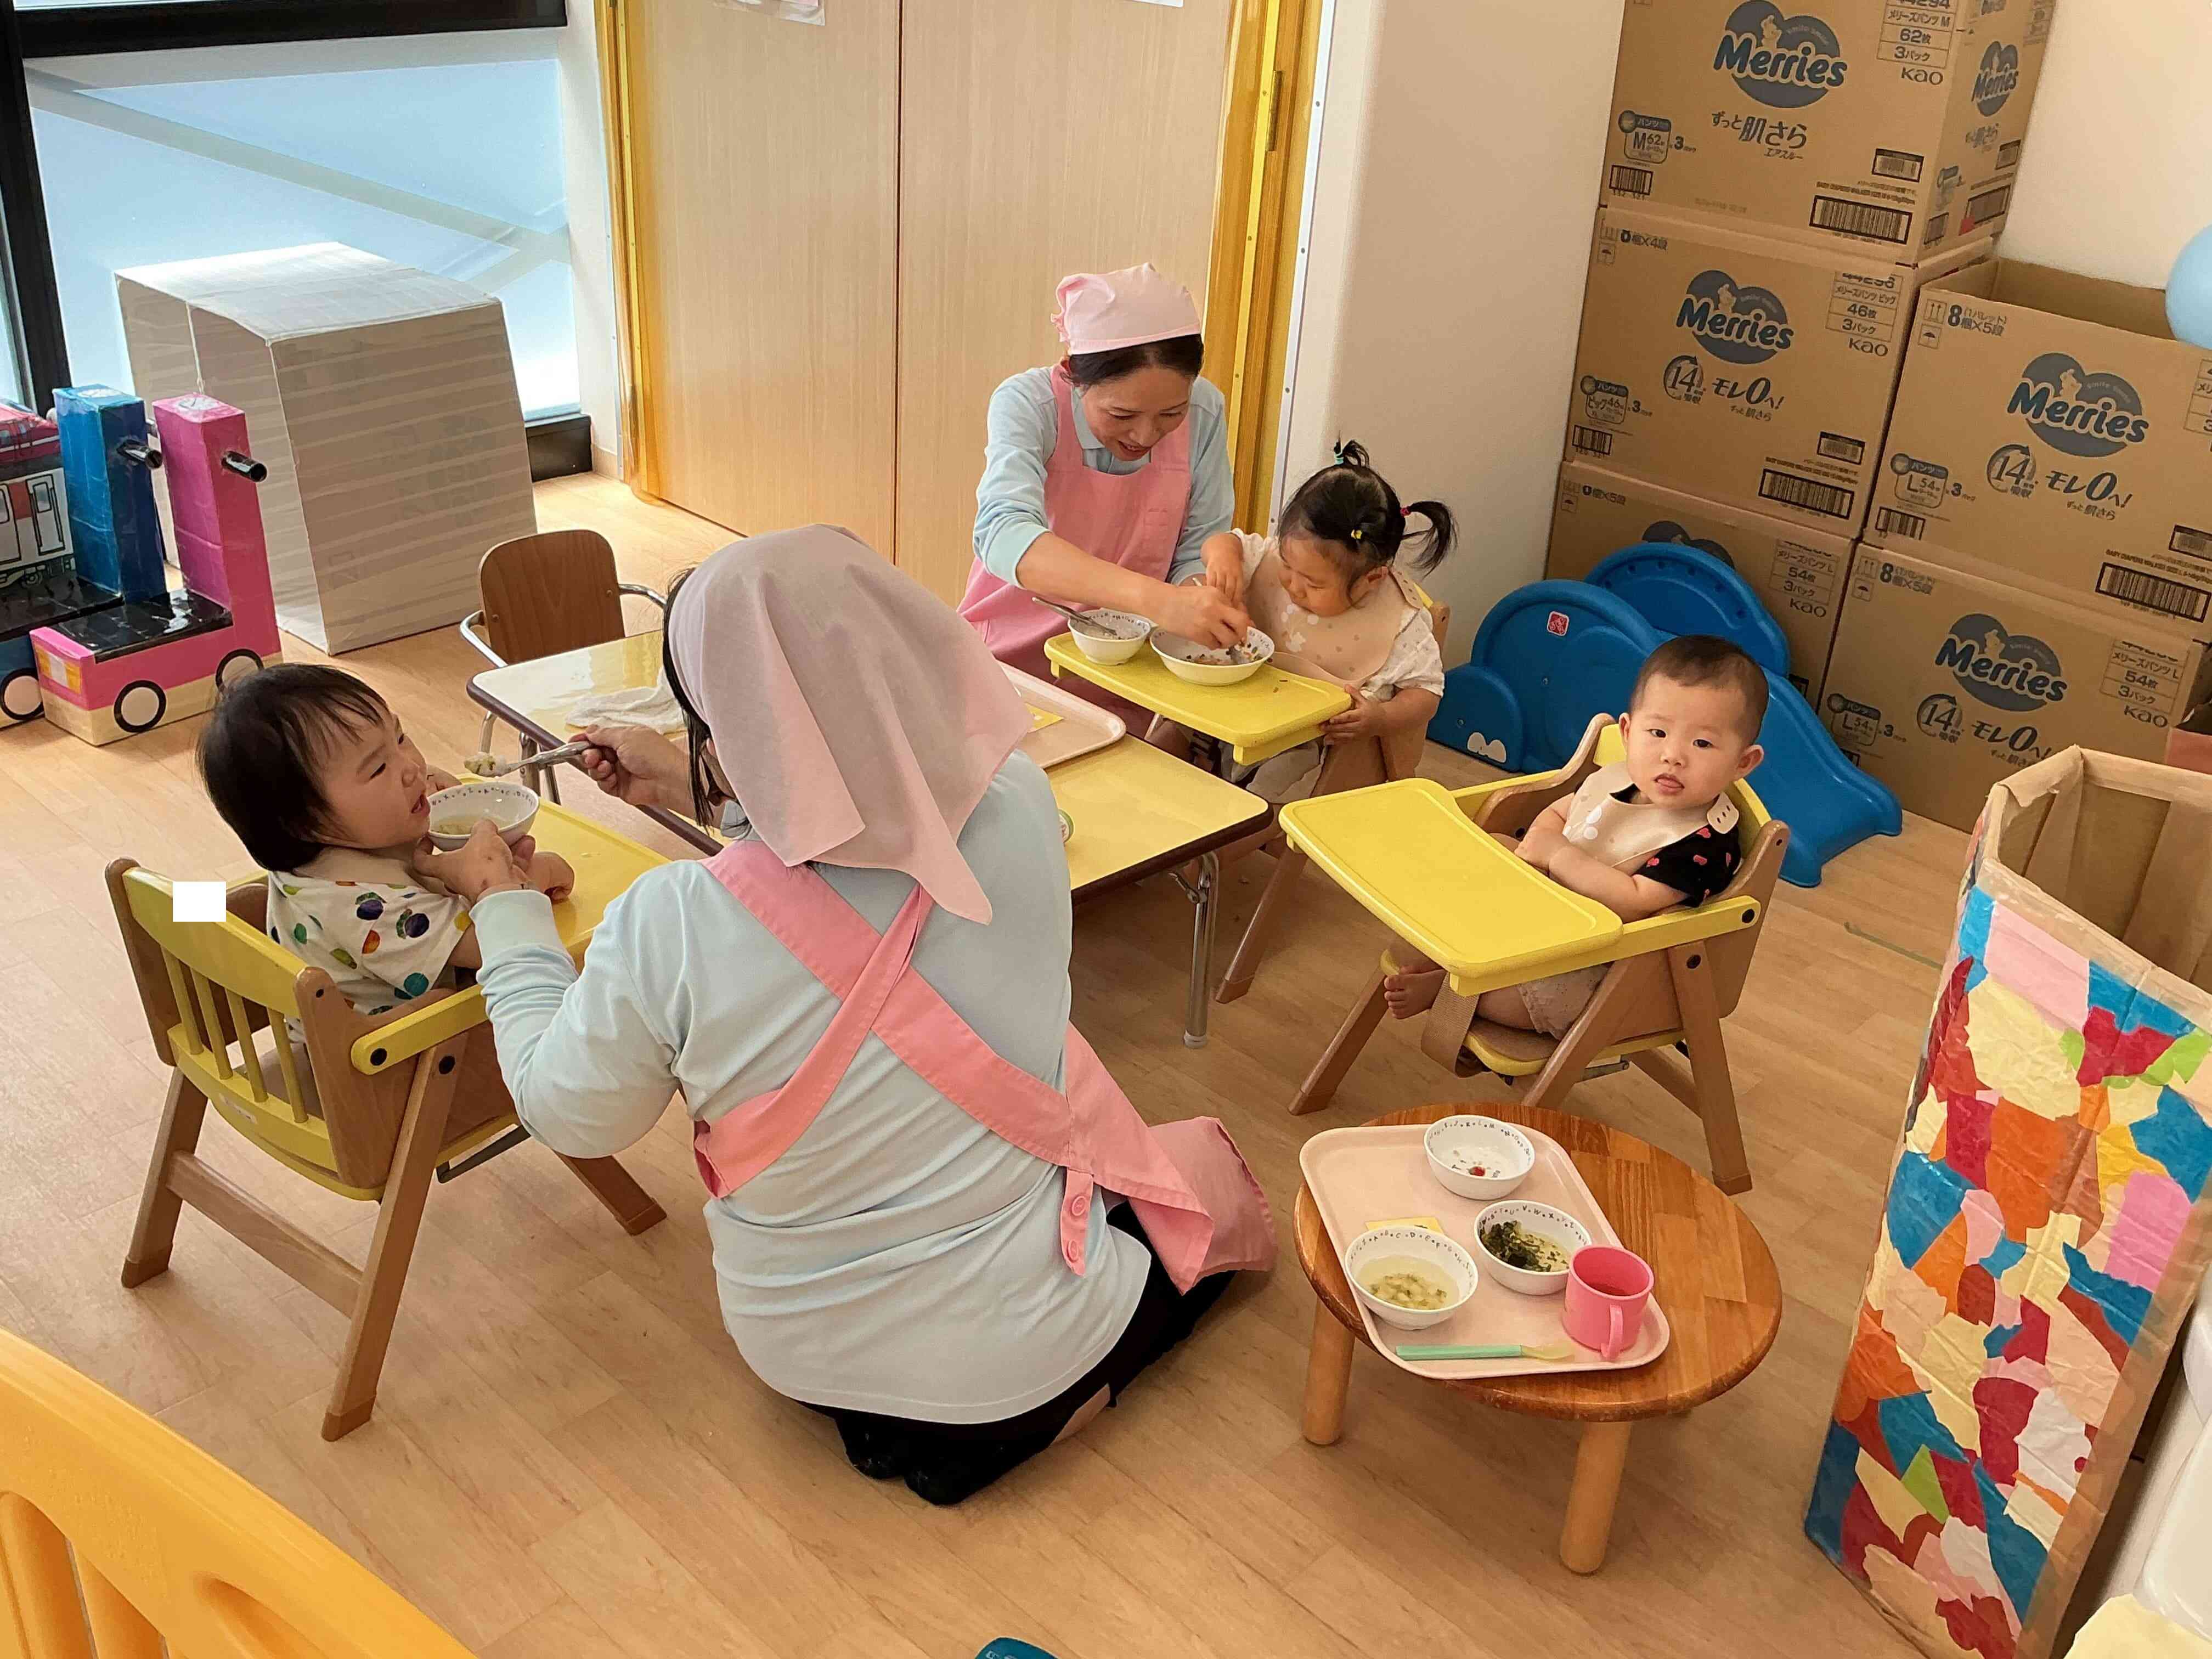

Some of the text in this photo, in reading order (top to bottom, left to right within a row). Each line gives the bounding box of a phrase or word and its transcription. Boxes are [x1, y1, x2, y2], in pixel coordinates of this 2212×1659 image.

[1713, 34, 1848, 87] Merries
[1894, 46, 1930, 62] 3パック
[1633, 131, 1646, 150] M
[1711, 110, 1807, 149] ずっと肌さら
[1676, 297, 1794, 349] Merries
[1842, 318, 1876, 335] 3パック
[1668, 366, 1699, 393] 14
[2007, 382, 2149, 443] Merries
[1907, 473, 1918, 493] L
[1992, 455, 2030, 485] 14
[1784, 579, 1815, 597] 3パック
[1935, 637, 2068, 702] Merries
[2112, 652, 2179, 679] メリーズパンツ L
[2118, 685, 2156, 704] 3パック
[1842, 713, 1853, 731] L
[1922, 703, 1957, 732] 14
